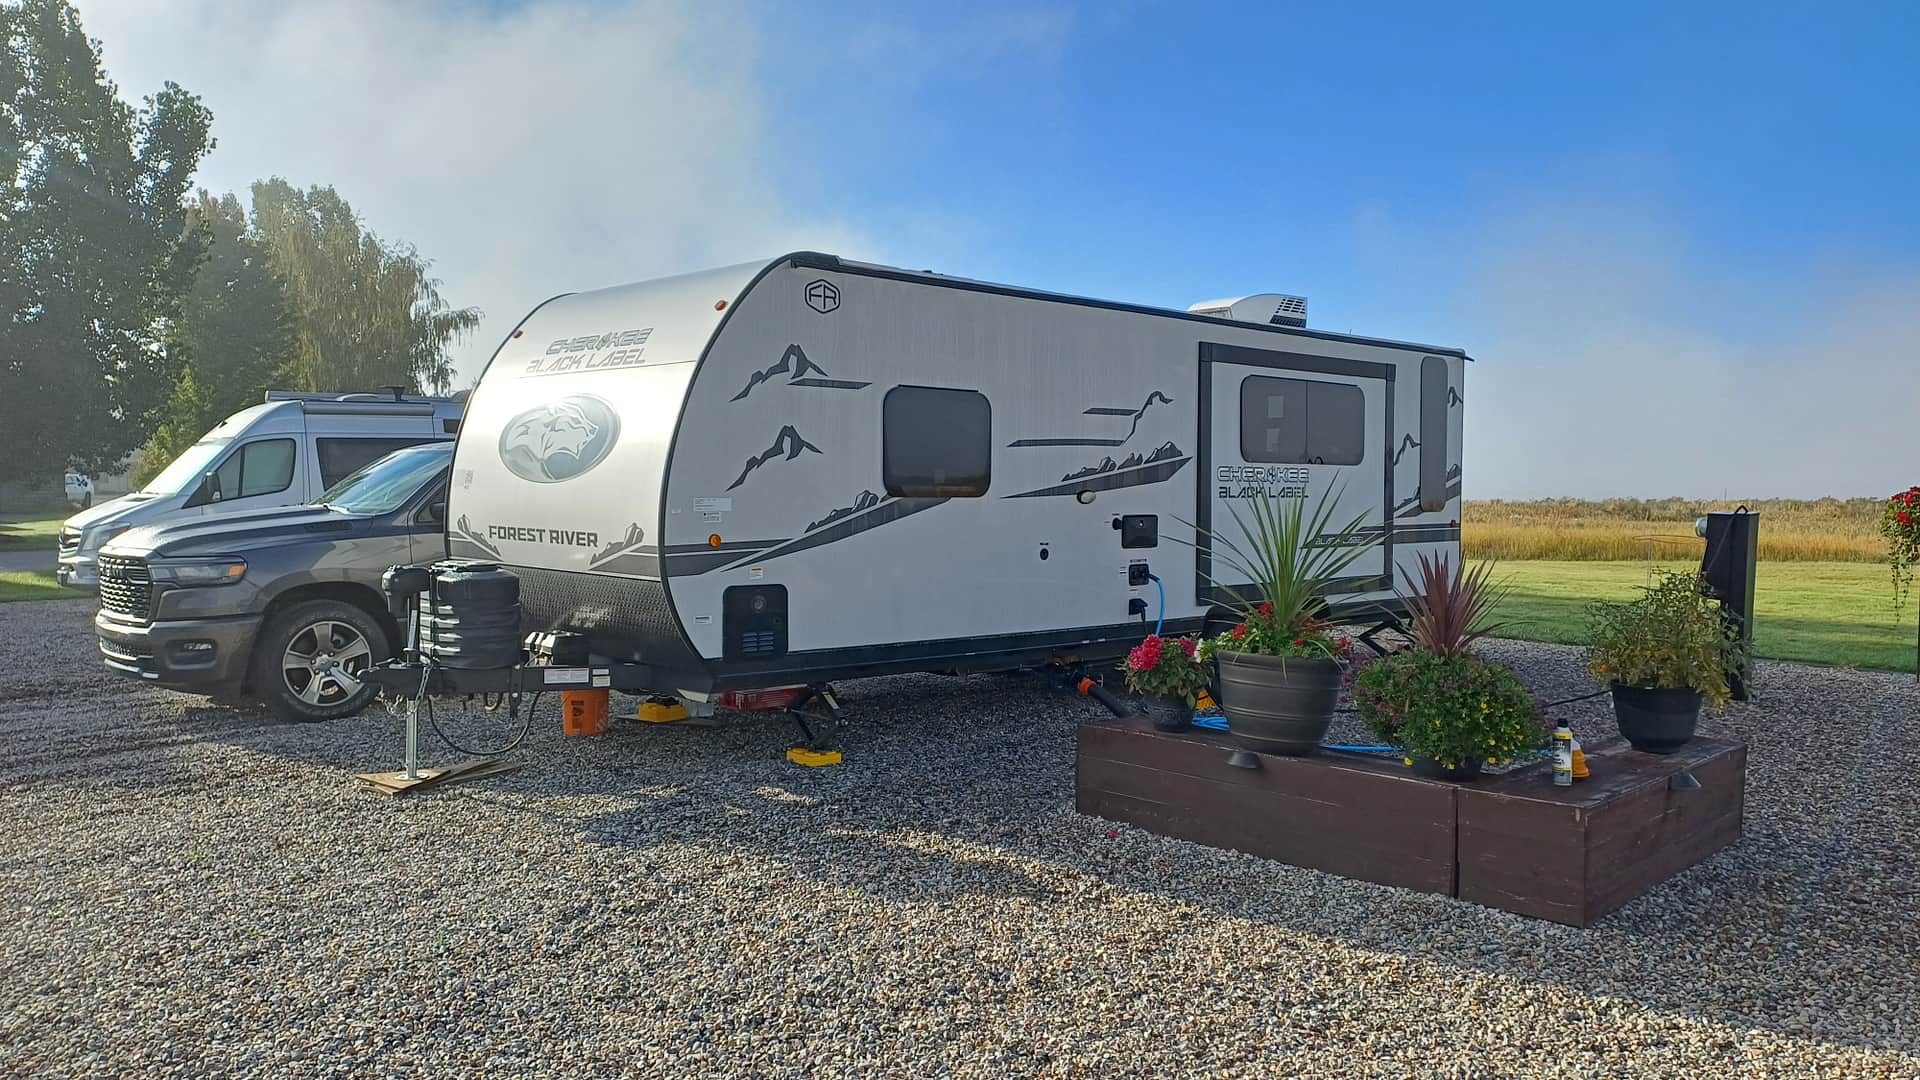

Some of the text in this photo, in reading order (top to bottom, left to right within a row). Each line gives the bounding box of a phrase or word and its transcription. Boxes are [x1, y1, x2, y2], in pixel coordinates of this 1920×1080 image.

[808, 283, 837, 310] FR
[546, 328, 654, 355] CHEROKEE
[526, 348, 646, 374] BLACK LABEL
[1217, 465, 1310, 484] CHEROKEE
[1218, 486, 1309, 498] BLACK LABEL
[488, 525, 598, 548] FOREST RIVER
